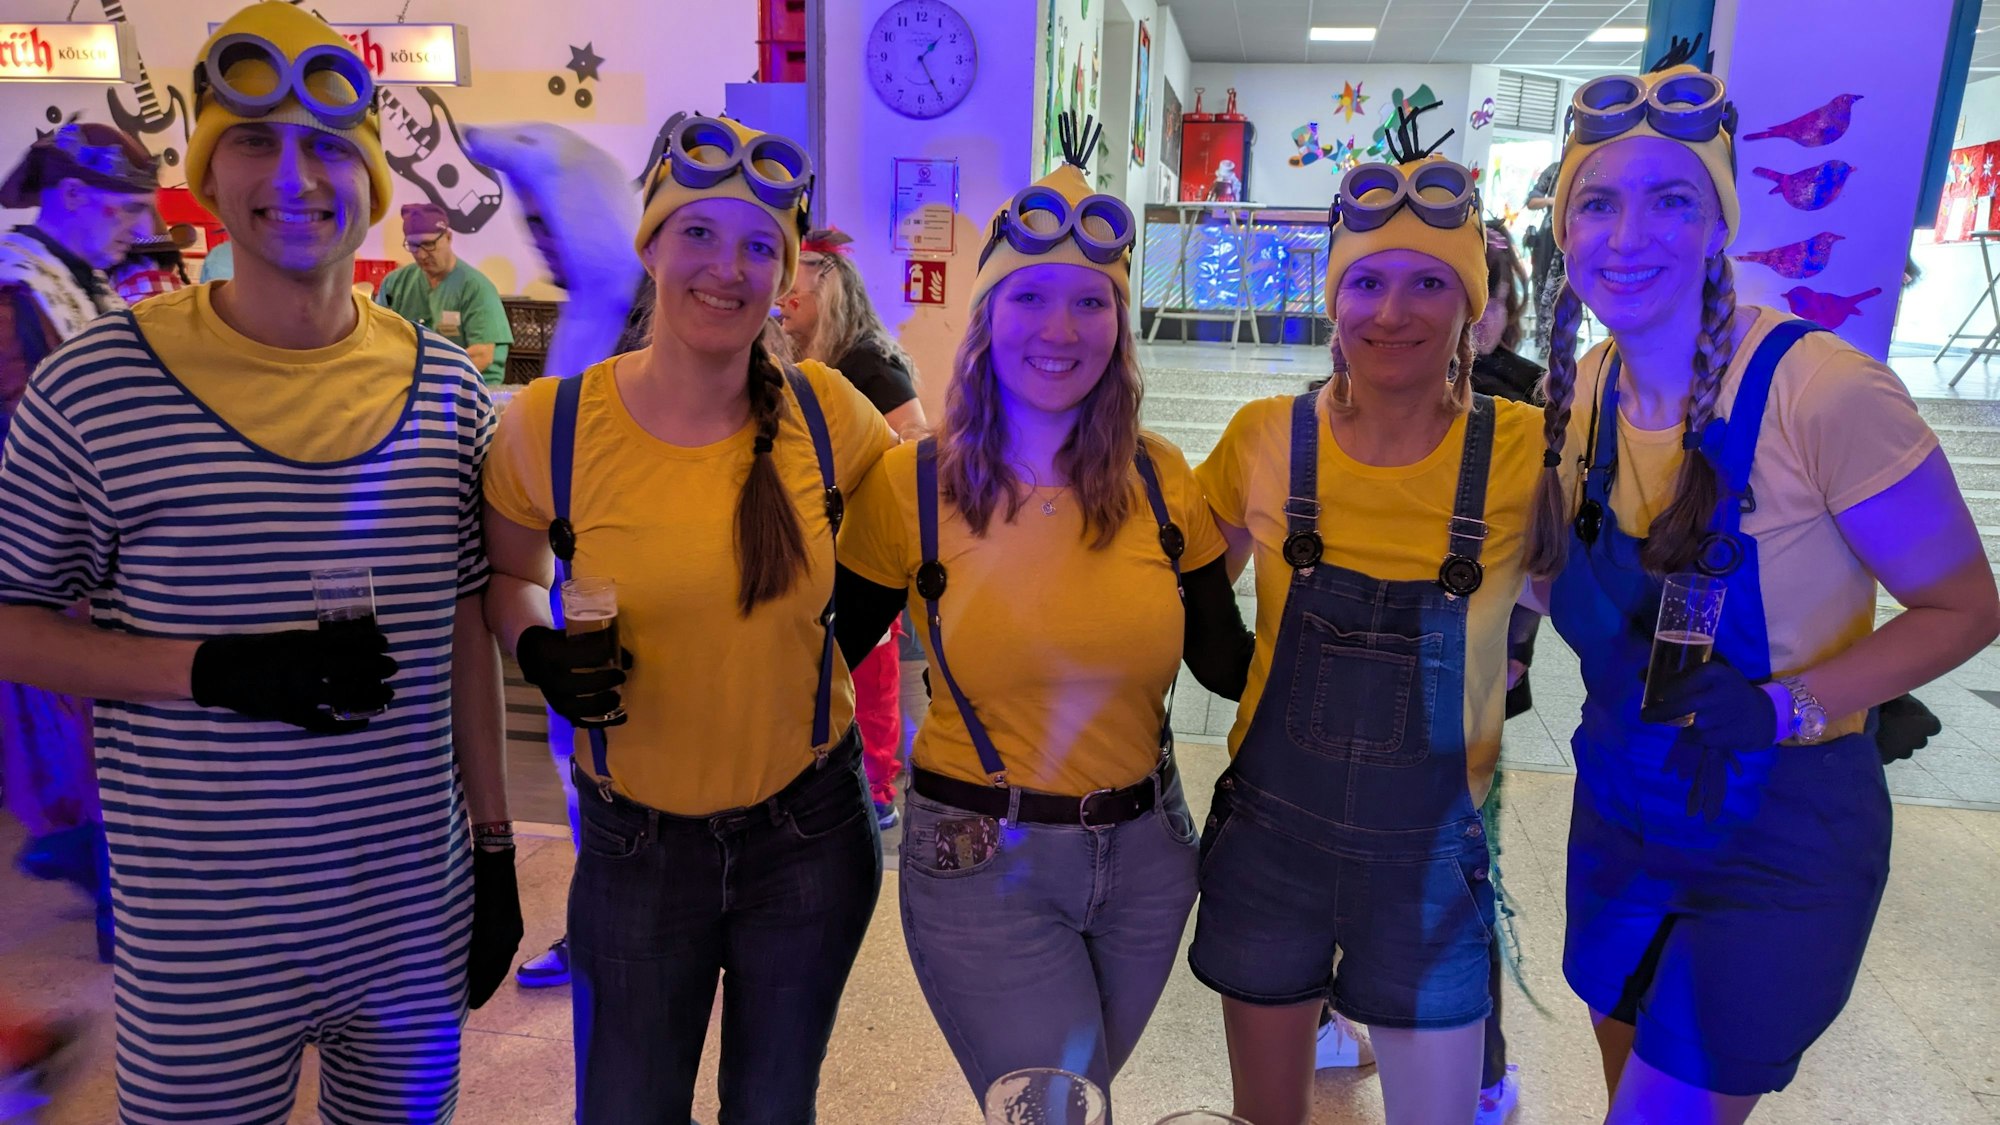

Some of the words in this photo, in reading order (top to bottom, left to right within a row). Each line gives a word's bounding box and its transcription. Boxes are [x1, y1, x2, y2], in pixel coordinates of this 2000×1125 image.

[916, 11, 929, 22] 12
[898, 17, 908, 27] 11
[938, 17, 942, 28] 1
[884, 32, 896, 42] 10
[949, 33, 957, 44] 2
[0, 27, 53, 73] rüh
[58, 46, 107, 60] KÖLSCH
[390, 49, 441, 63] KÖLSC
[880, 52, 888, 62] 9
[955, 55, 963, 65] 3
[885, 73, 893, 83] 8
[949, 75, 956, 85] 4
[897, 89, 904, 100] 7
[936, 91, 944, 102] 5
[917, 95, 925, 105] 6
